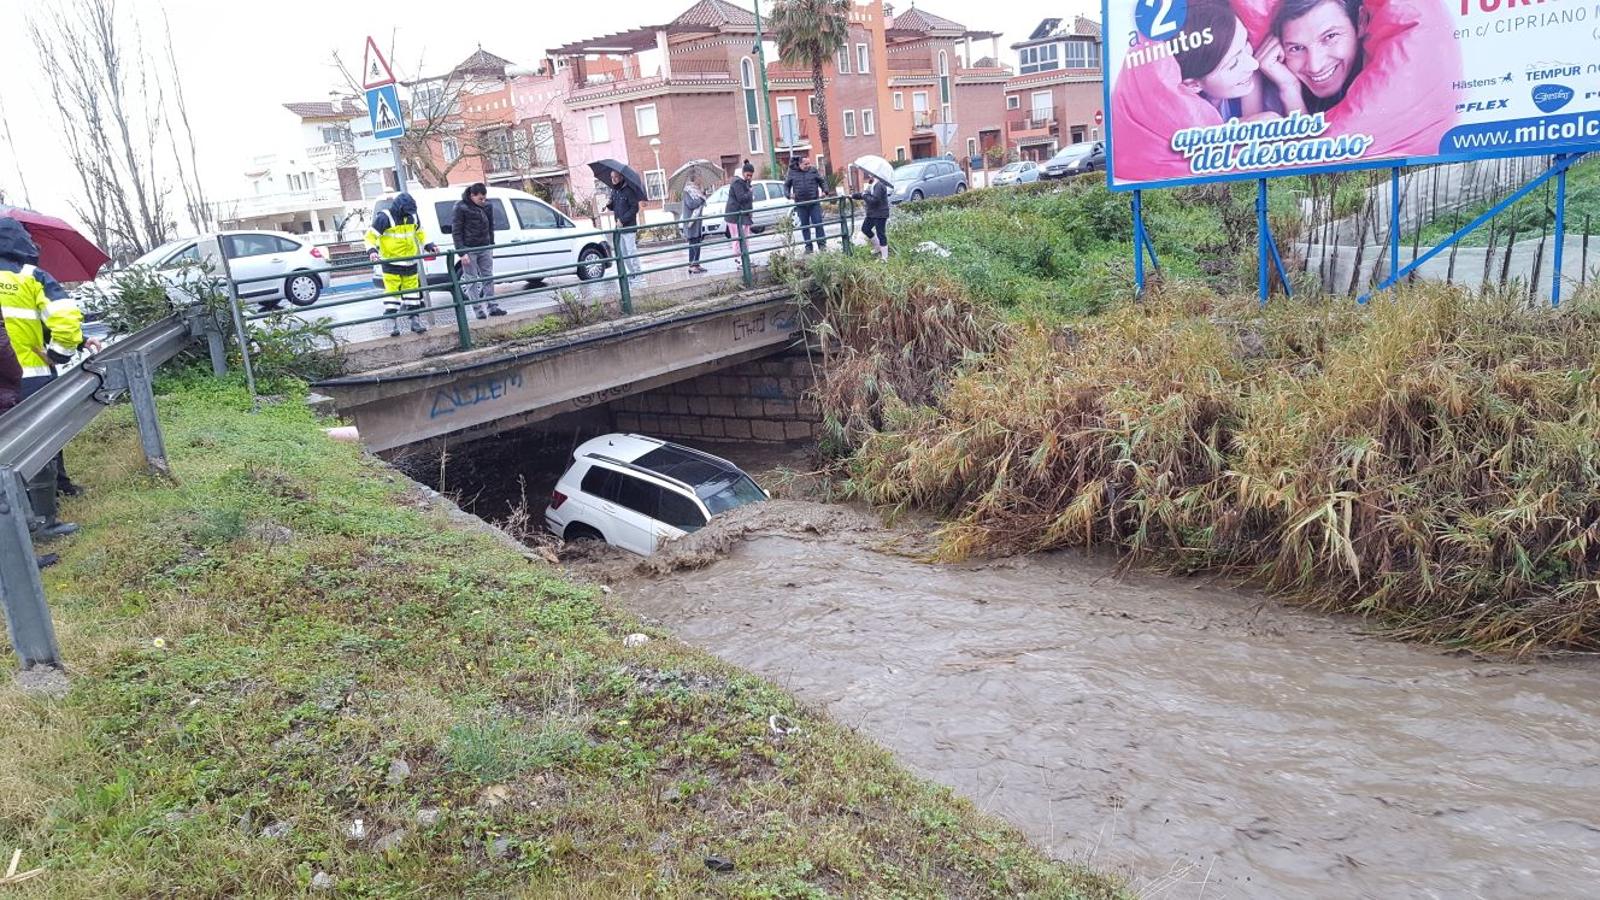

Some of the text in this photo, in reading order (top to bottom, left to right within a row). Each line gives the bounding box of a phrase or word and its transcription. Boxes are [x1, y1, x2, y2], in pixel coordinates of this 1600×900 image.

[1128, 0, 1177, 47] a 2
[1453, 28, 1470, 40] en
[1475, 22, 1490, 37] c/
[1495, 7, 1587, 34] CIPRIANO
[1126, 27, 1214, 69] minutos
[1526, 66, 1582, 81] TEMPUR
[1173, 112, 1327, 153] apasionados
[1193, 134, 1373, 172] del descanso
